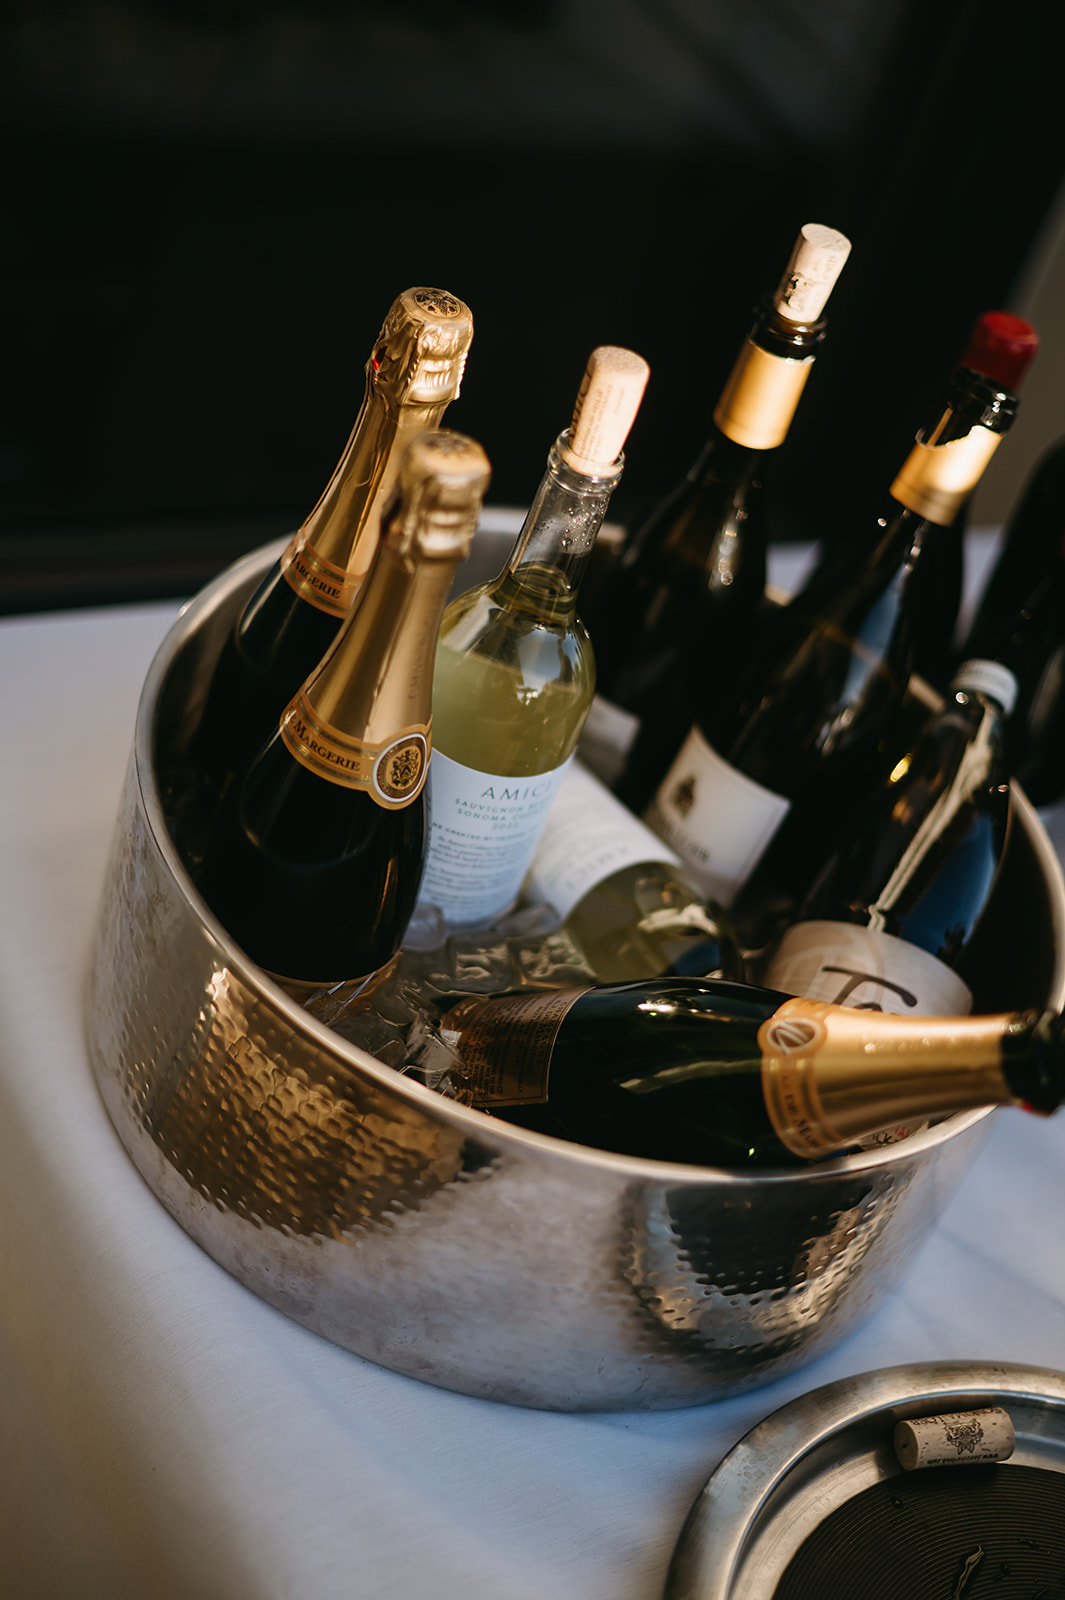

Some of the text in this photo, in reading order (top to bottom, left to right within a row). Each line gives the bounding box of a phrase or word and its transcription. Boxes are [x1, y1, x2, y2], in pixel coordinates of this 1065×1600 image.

[293, 722, 361, 772] MARGERIE
[481, 780, 553, 801] AMICI
[455, 797, 524, 814] SAUVIGNON
[458, 807, 506, 821] SONOMA
